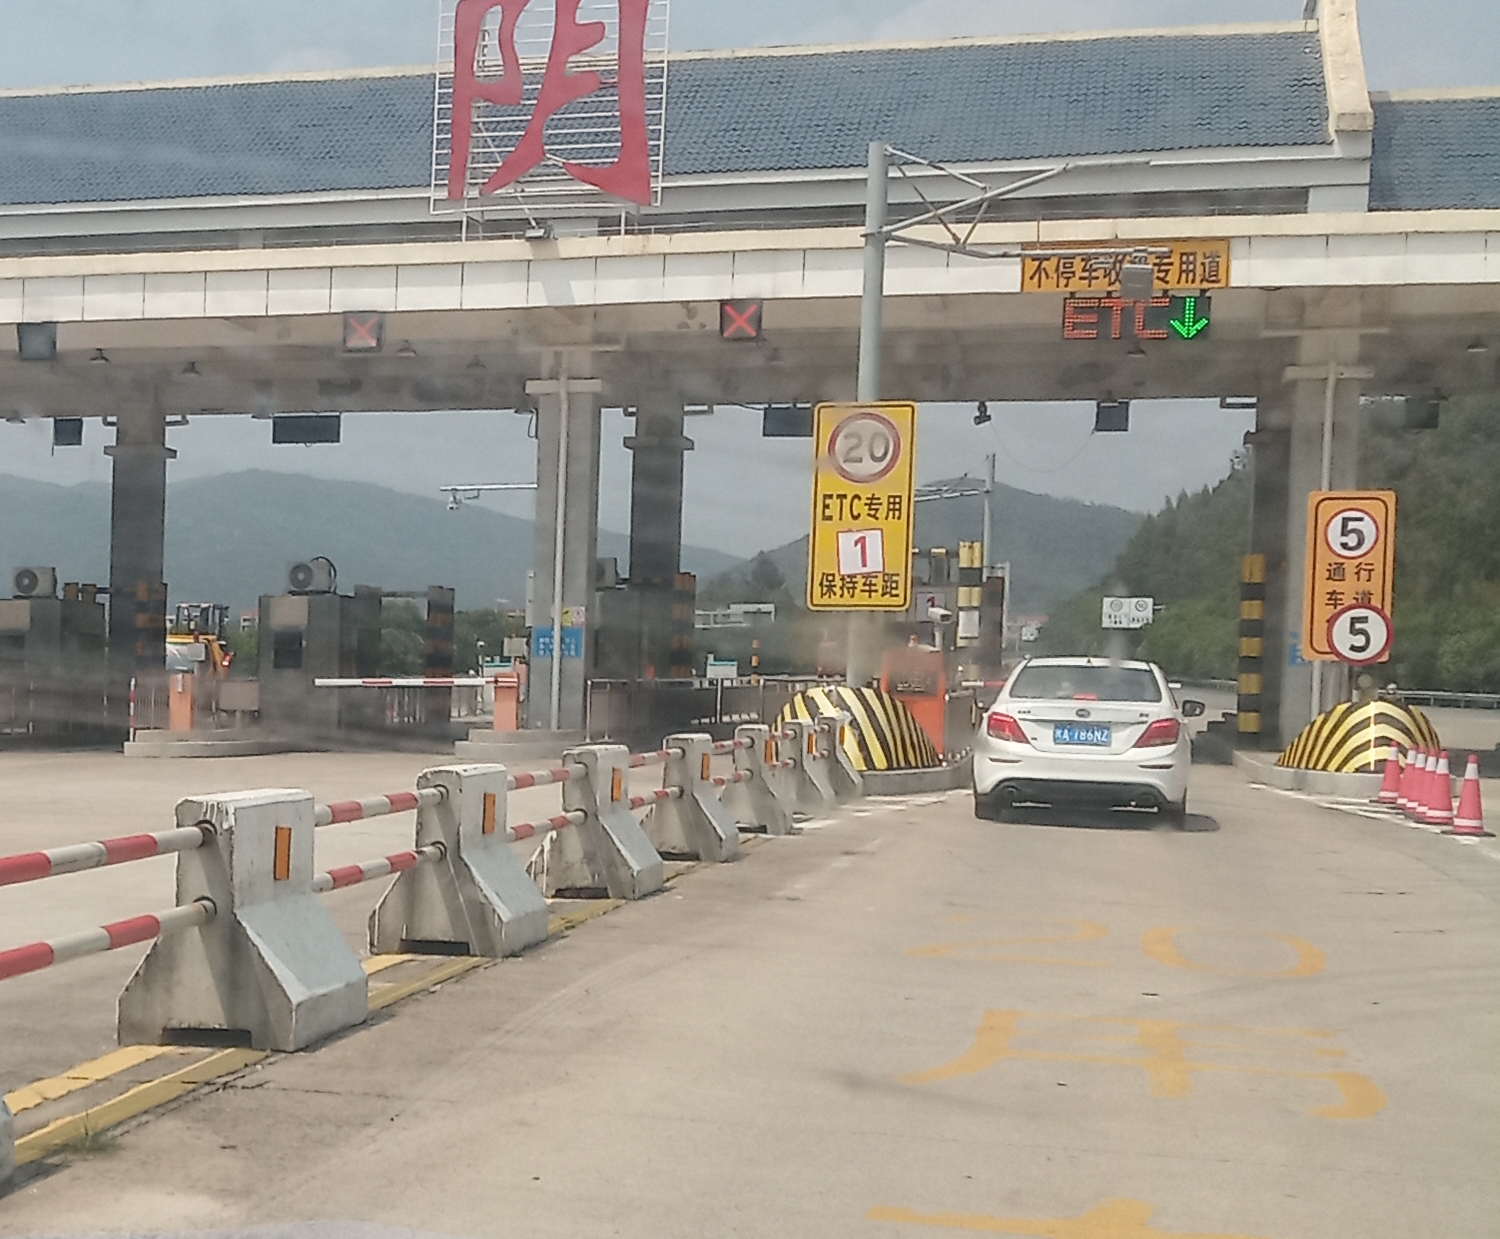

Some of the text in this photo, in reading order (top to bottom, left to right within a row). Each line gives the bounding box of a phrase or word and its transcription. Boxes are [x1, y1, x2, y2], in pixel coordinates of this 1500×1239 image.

[1063, 297, 1170, 339] ETC
[843, 431, 892, 464] 20
[821, 492, 903, 522] ETC专用
[1339, 516, 1366, 552] 5
[853, 535, 868, 568] 1
[818, 571, 901, 600] 保持车距
[1325, 561, 1376, 583] 通行
[1348, 615, 1372, 654] 5
[904, 914, 1328, 978] 20
